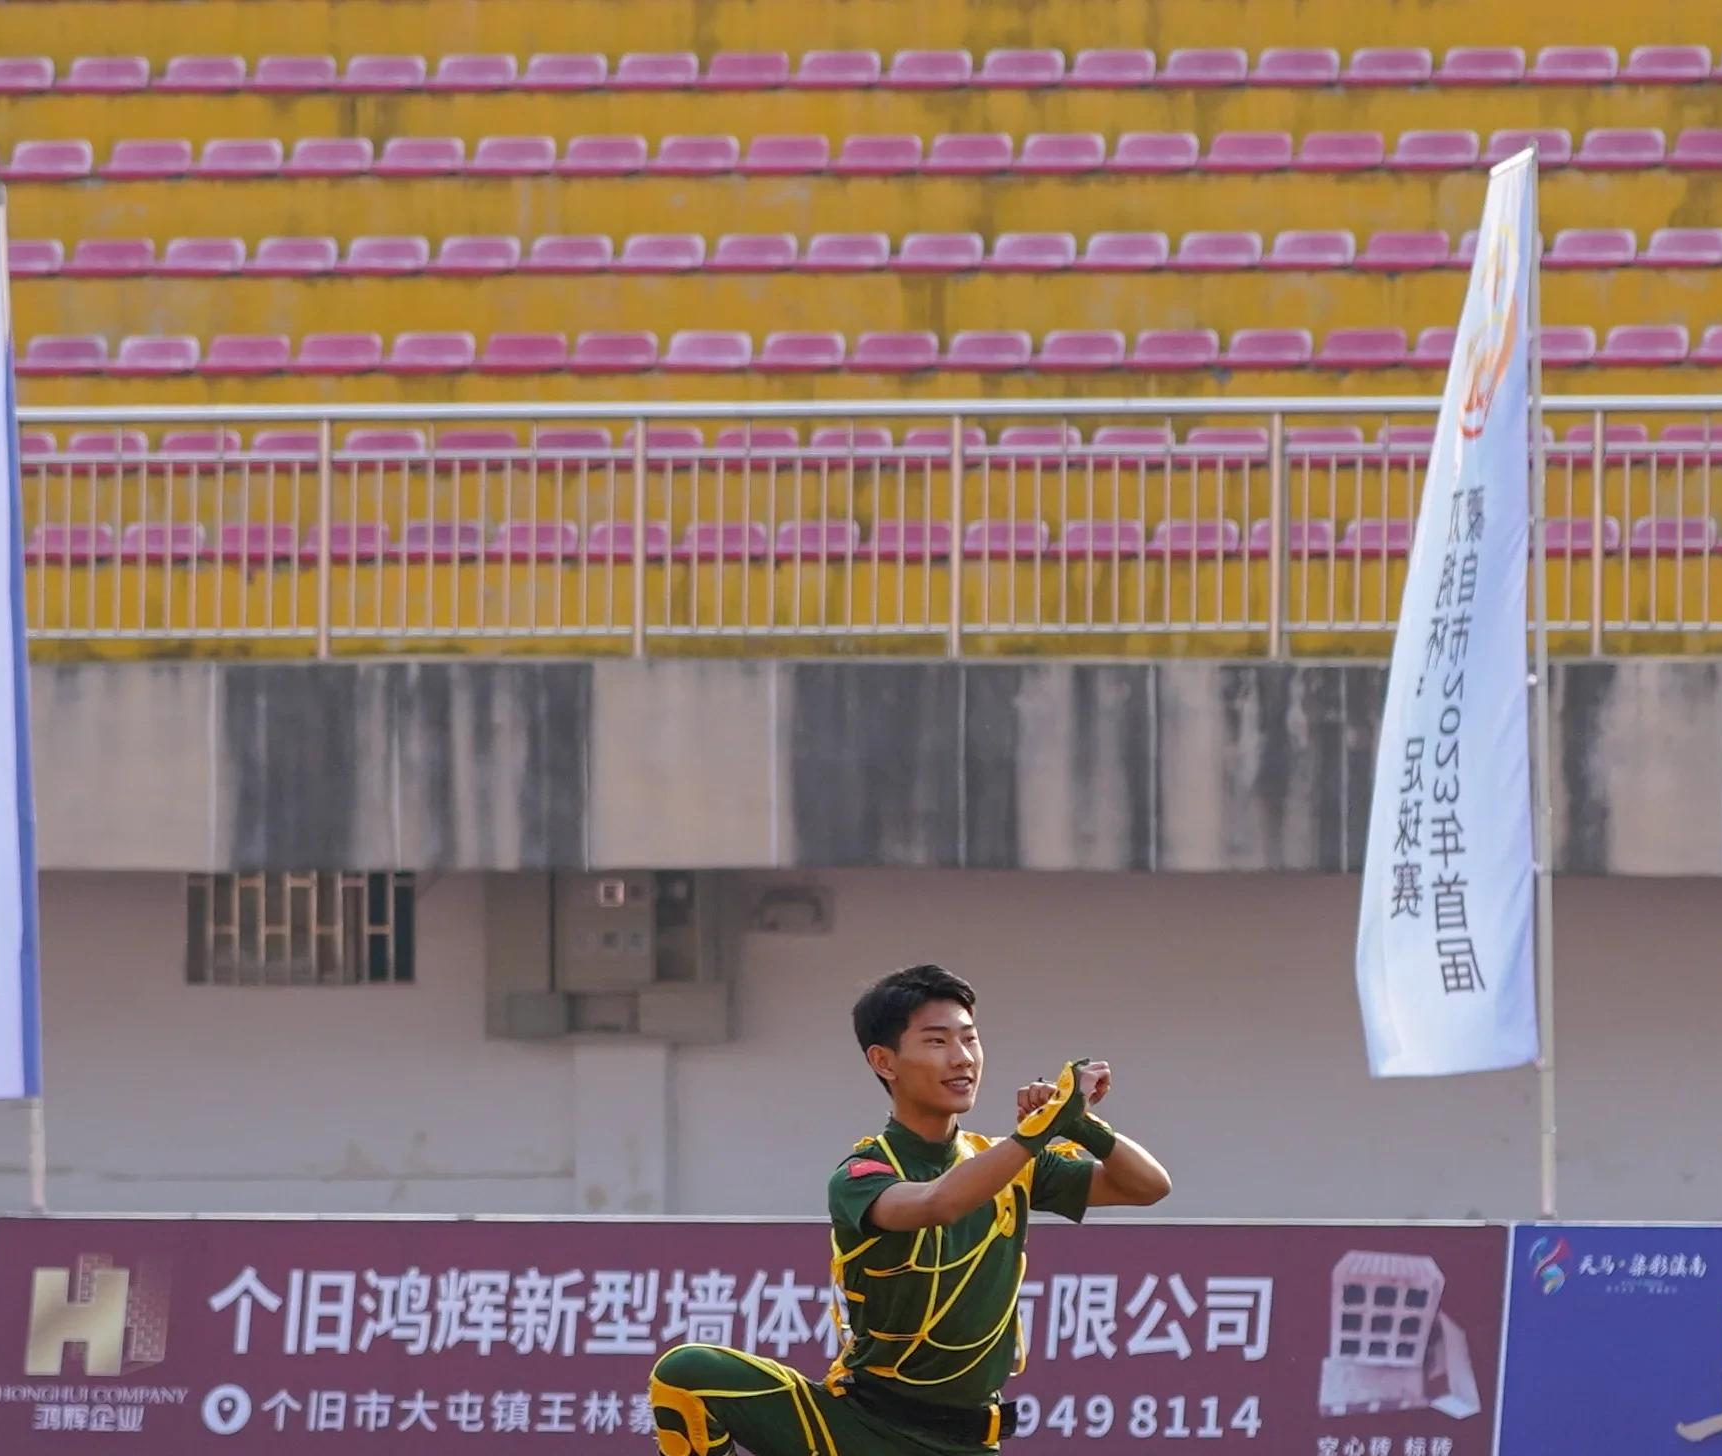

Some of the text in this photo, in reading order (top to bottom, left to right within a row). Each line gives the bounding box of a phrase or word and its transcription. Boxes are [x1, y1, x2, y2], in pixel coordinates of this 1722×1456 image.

[91, 1386, 189, 1404] COMPANY
[33, 1403, 145, 1432] 鸿辉企业
[1129, 1394, 1262, 1439] 8114
